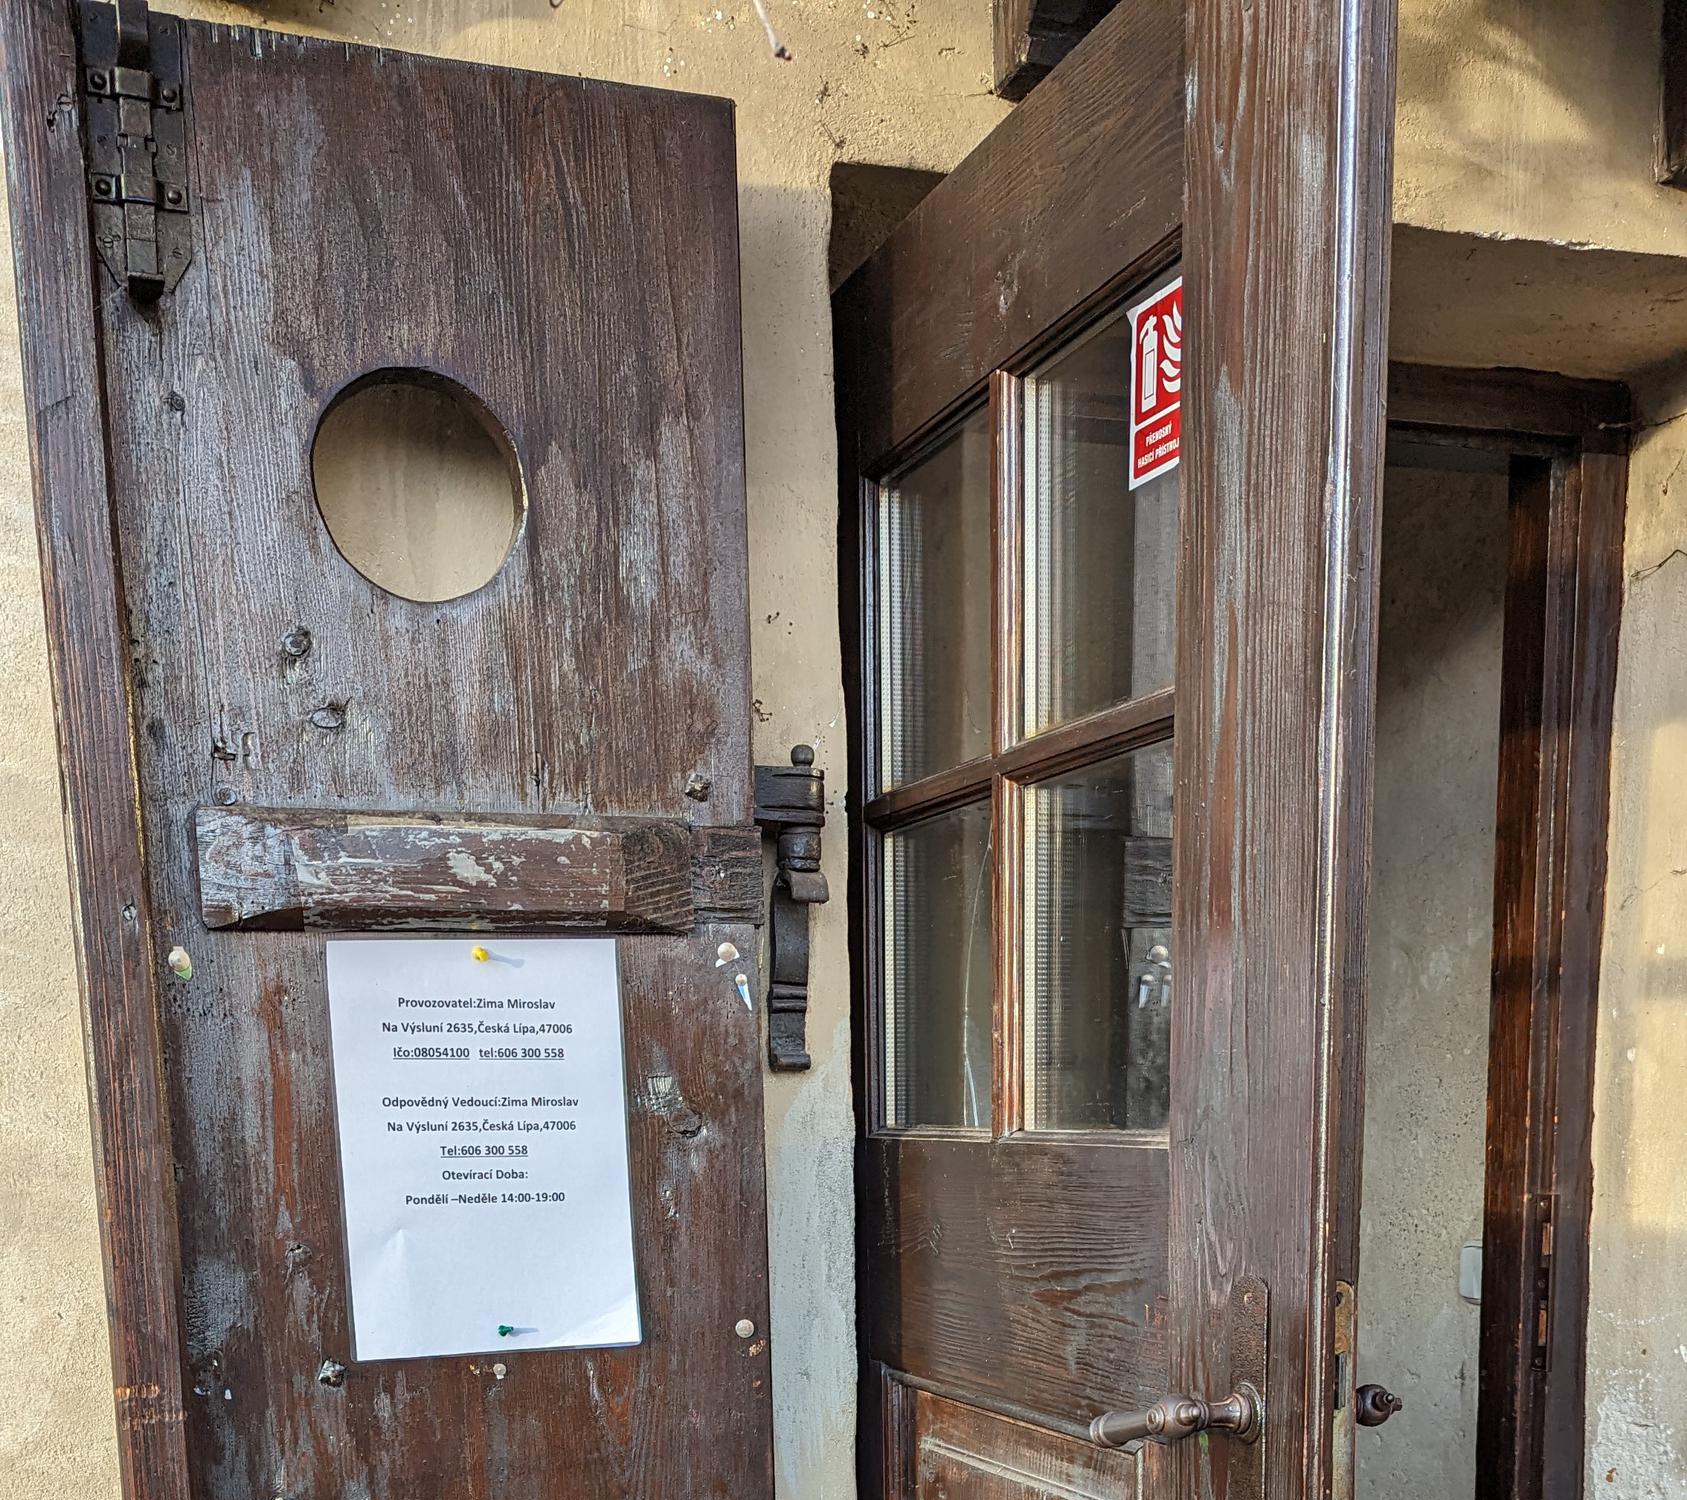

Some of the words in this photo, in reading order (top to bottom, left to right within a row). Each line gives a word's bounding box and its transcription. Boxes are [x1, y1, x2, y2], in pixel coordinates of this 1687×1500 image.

[398, 998, 504, 1009] Provozovatel:Zima
[507, 999, 556, 1010] Miroslav
[382, 1023, 398, 1033] Na
[401, 1022, 444, 1035] Výsluní
[513, 1023, 573, 1036] Lípa,47006
[479, 1048, 519, 1058] tel:606
[521, 1048, 541, 1058] 300
[544, 1048, 564, 1058] 558
[382, 1096, 449, 1109] Odpovědný
[452, 1096, 528, 1107] Vedoucí:Zima
[531, 1097, 579, 1106] Miroslav
[387, 1122, 403, 1132] Na
[406, 1121, 449, 1134] Výsluní
[517, 1121, 576, 1133] Lípa,47006
[440, 1146, 482, 1156] Tel:606
[485, 1146, 505, 1155] 300
[508, 1145, 528, 1155] 558
[442, 1170, 494, 1180] Otevírací
[495, 1169, 528, 1179] Doba:
[405, 1194, 449, 1205] Pondělí
[501, 1192, 565, 1203] 14:00-19:00
